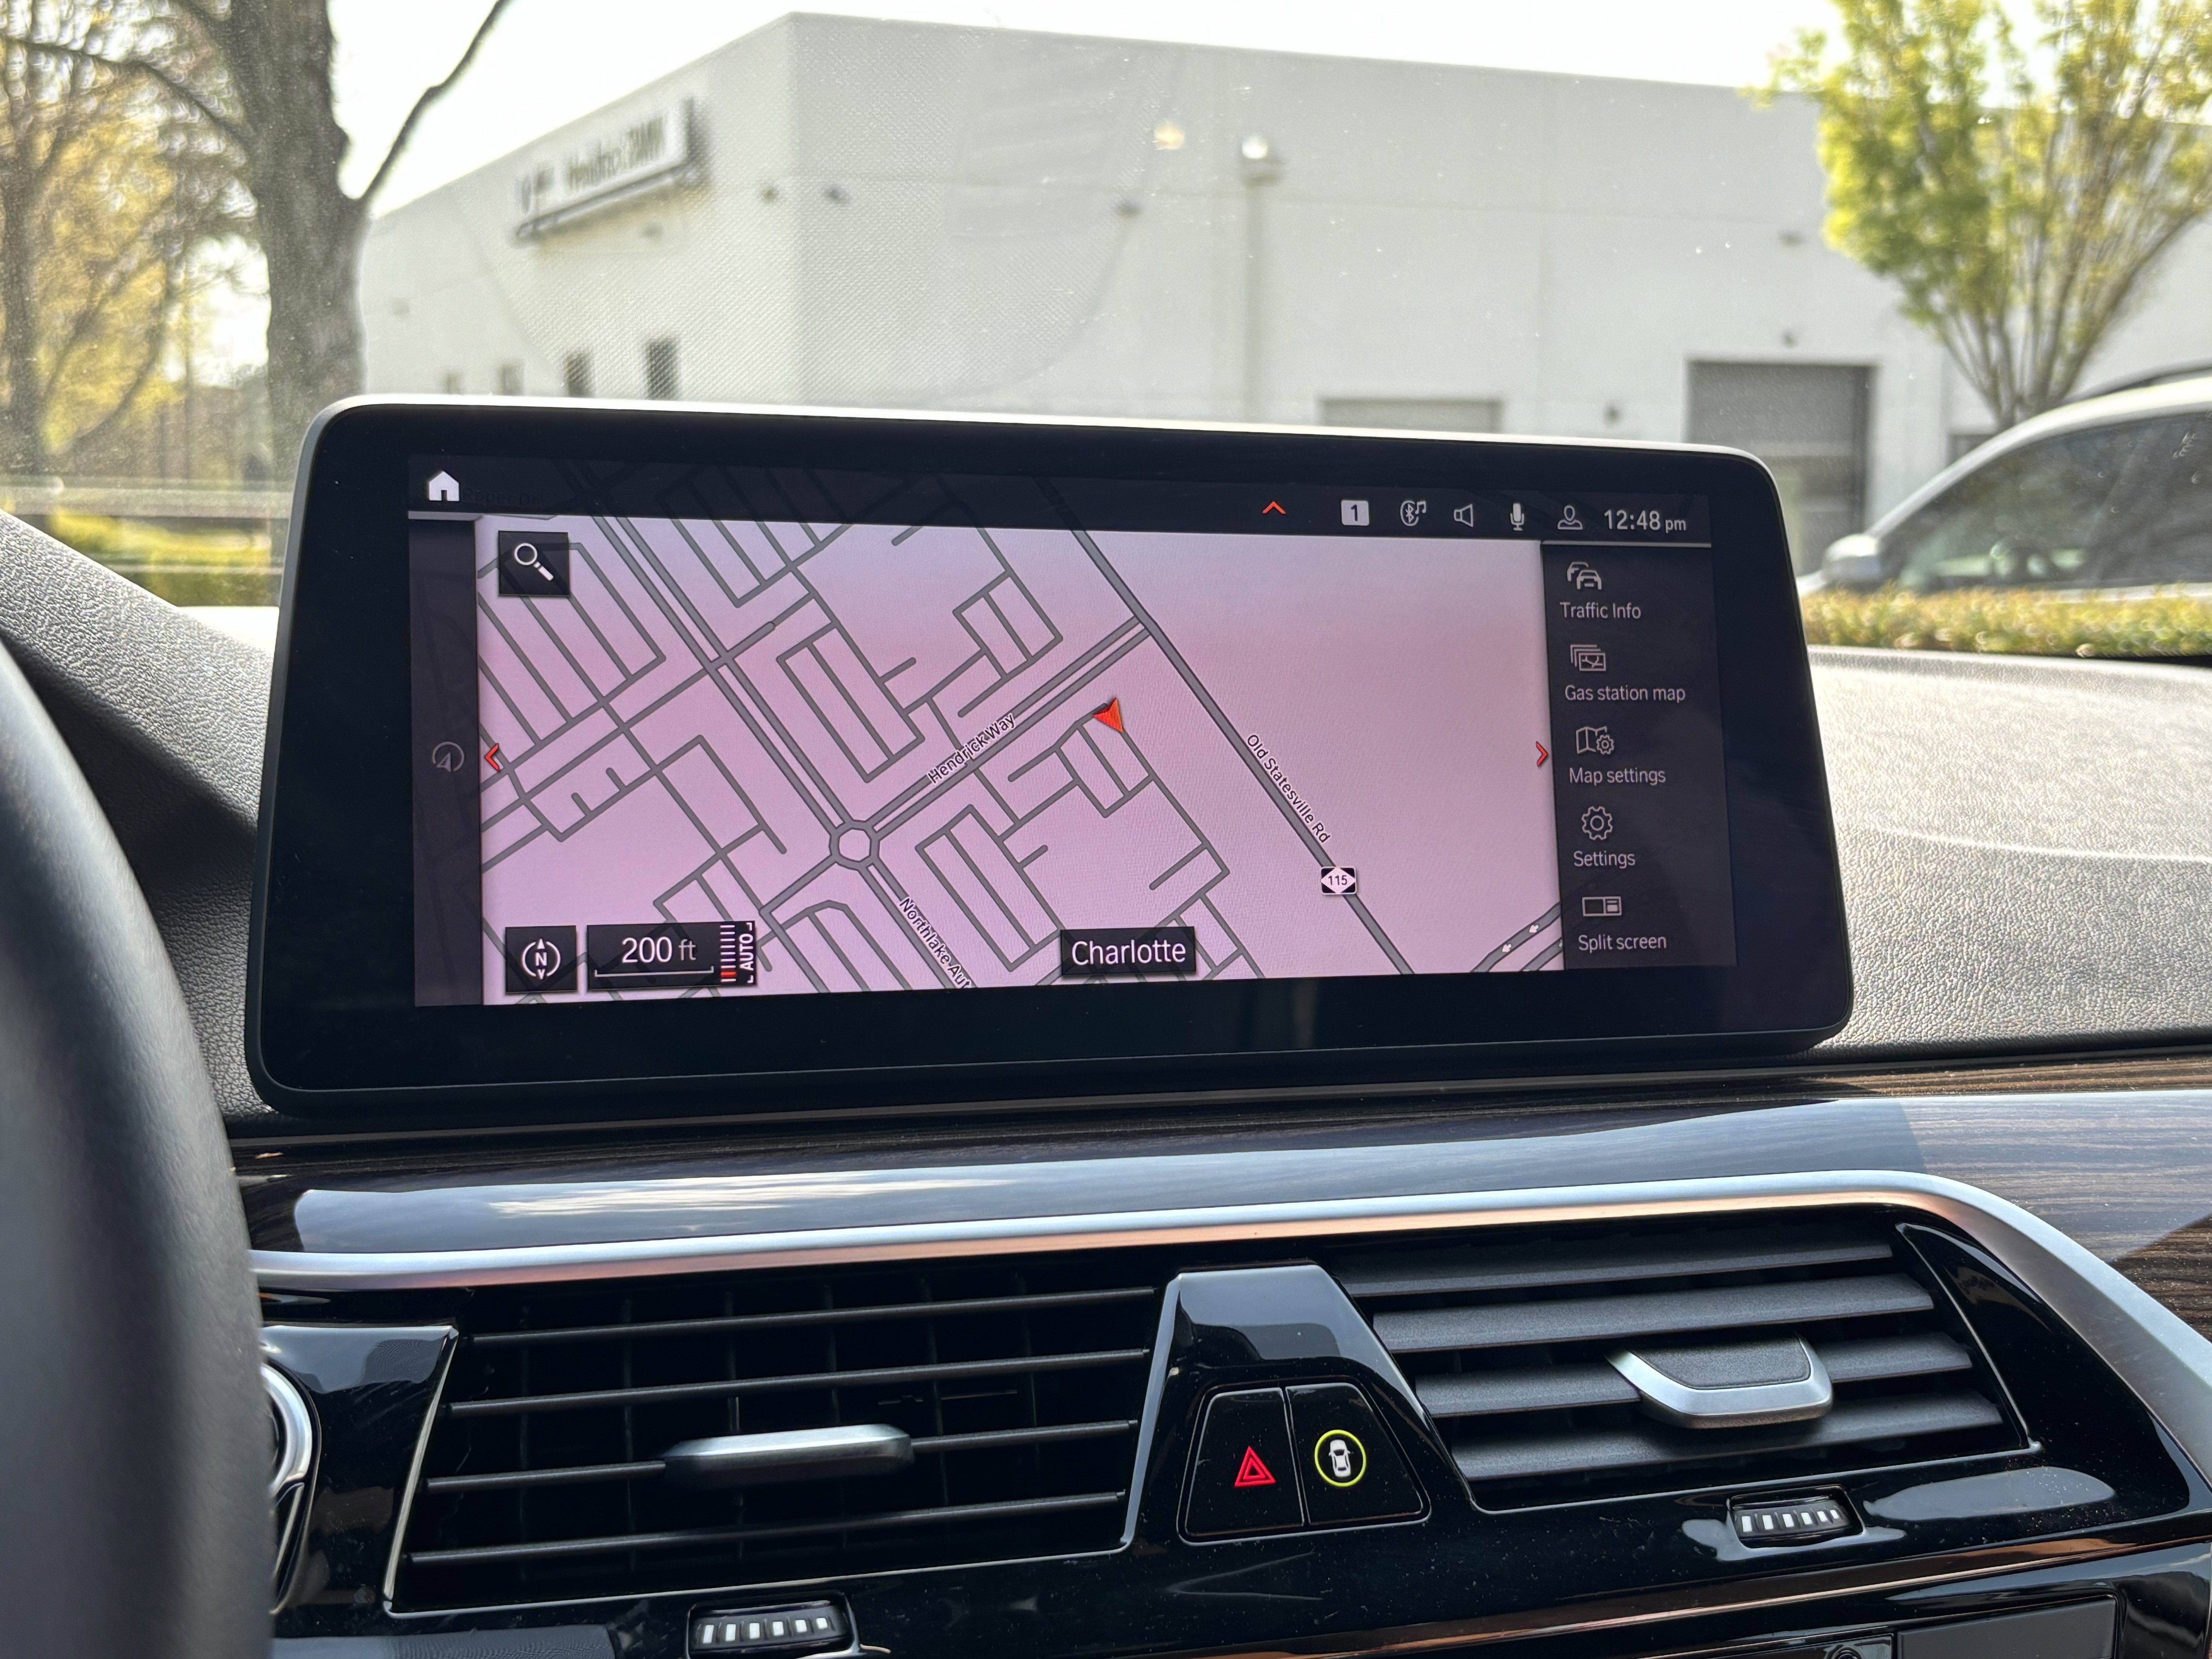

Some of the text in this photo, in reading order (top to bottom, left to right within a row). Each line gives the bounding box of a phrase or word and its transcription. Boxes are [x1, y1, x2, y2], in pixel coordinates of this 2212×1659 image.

[1350, 504, 1358, 522] 1
[1604, 509, 1686, 534] 12:48 pm
[1559, 601, 1641, 619] Traffic Info
[1565, 684, 1686, 703] Gas station map
[928, 714, 1015, 783] Hendrick Way
[1569, 767, 1666, 786] Map settings
[1247, 735, 1330, 843] Old Statesville Rd
[1573, 850, 1635, 869] Settings
[1328, 874, 1348, 886] 115
[899, 898, 950, 964] Northlake
[622, 936, 696, 963] 200 ft
[738, 933, 754, 971] AUTO
[1072, 939, 1186, 965] Charlotte
[1578, 934, 1667, 953] Split screen
